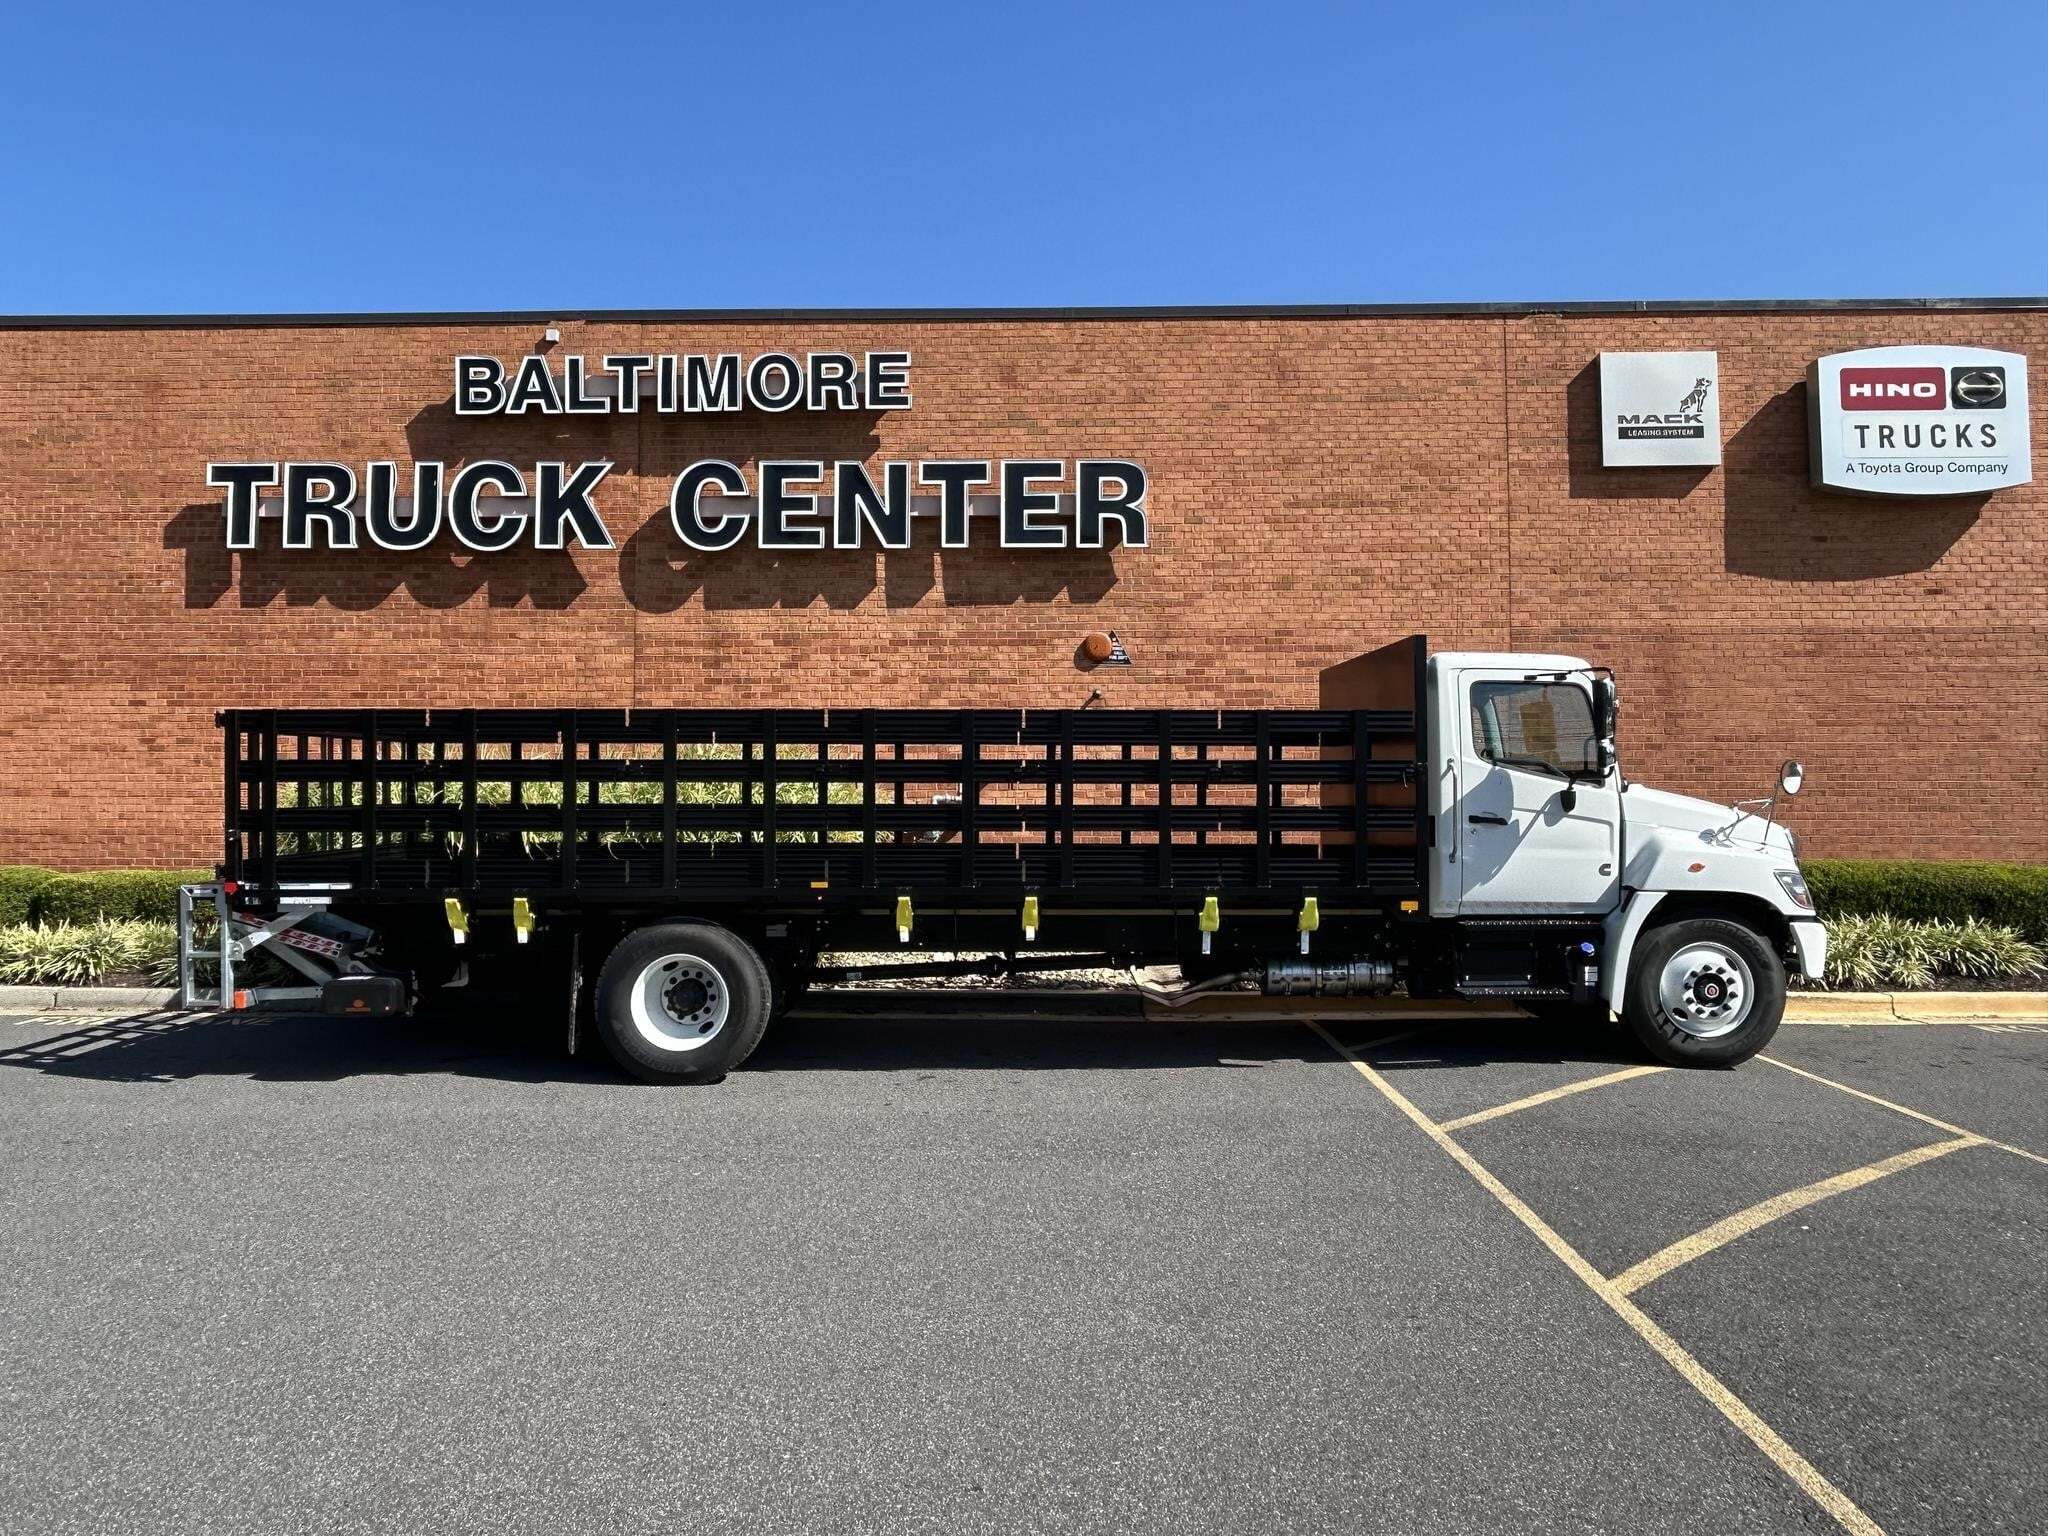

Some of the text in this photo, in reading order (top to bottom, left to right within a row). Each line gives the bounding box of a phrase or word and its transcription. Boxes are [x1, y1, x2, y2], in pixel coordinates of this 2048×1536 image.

[455, 351, 912, 415] BALTIMORE
[1850, 383, 1937, 397] HINO
[1617, 414, 1703, 424] MACK
[1628, 428, 1694, 437] LEASING SYSTEM
[1854, 423, 1997, 449] TRUCKS
[1845, 461, 2008, 475] A Toyota Group Company
[206, 459, 1149, 552] TRUCK CENTER
